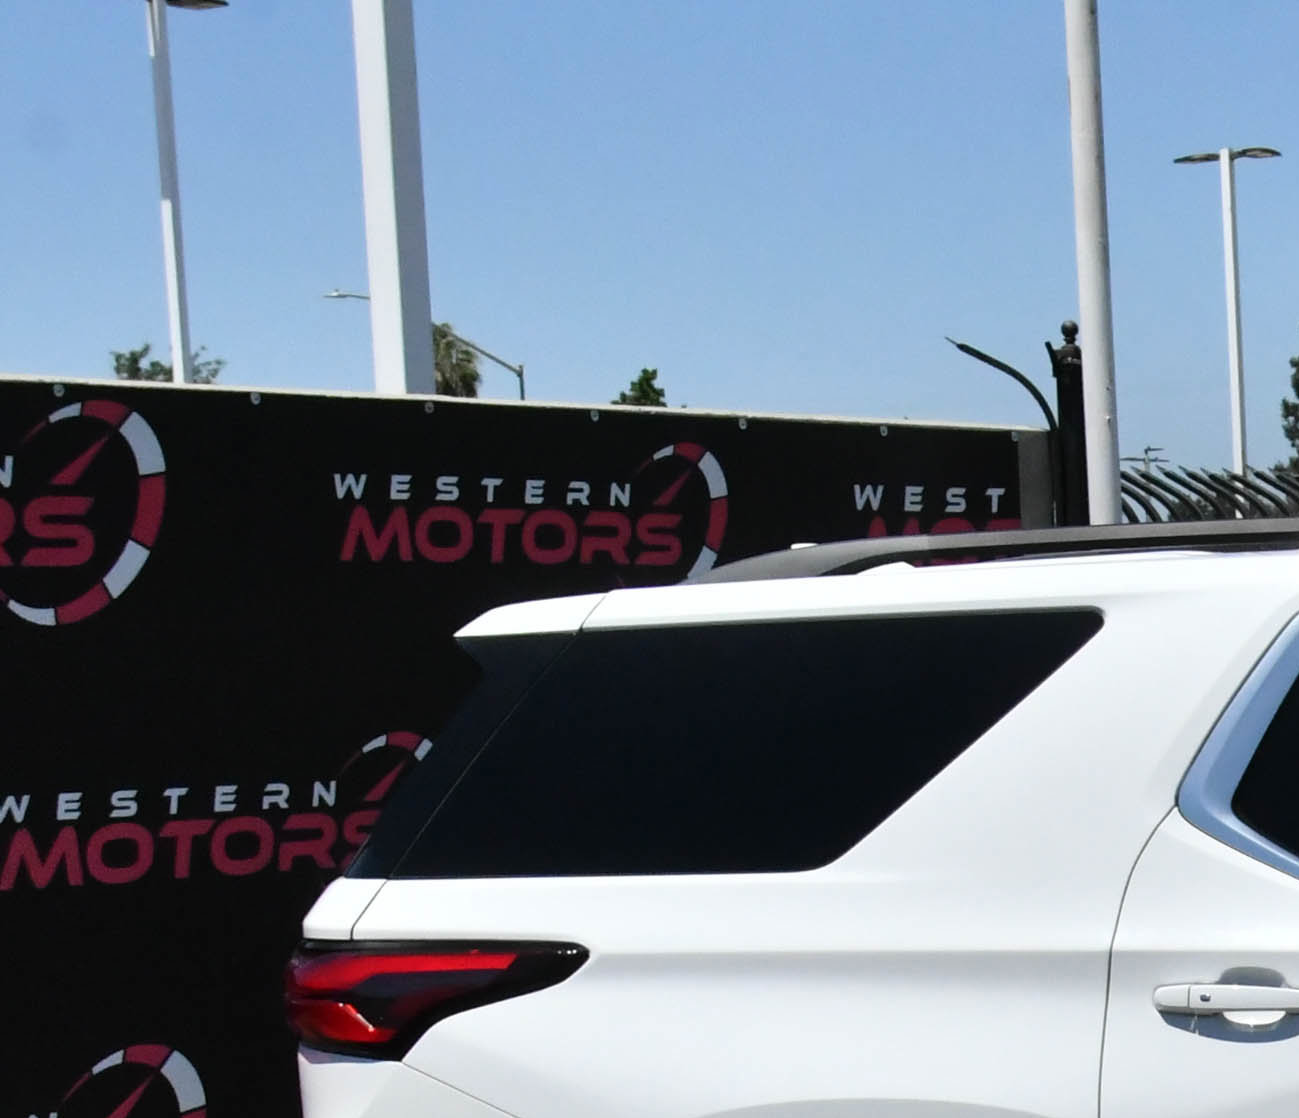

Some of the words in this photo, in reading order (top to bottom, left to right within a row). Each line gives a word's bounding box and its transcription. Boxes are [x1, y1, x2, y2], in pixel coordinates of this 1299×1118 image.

[333, 473, 632, 507] WESTERN
[853, 484, 1006, 513] WEST
[340, 505, 684, 566] MOTORS
[0, 781, 337, 823] WESTERN
